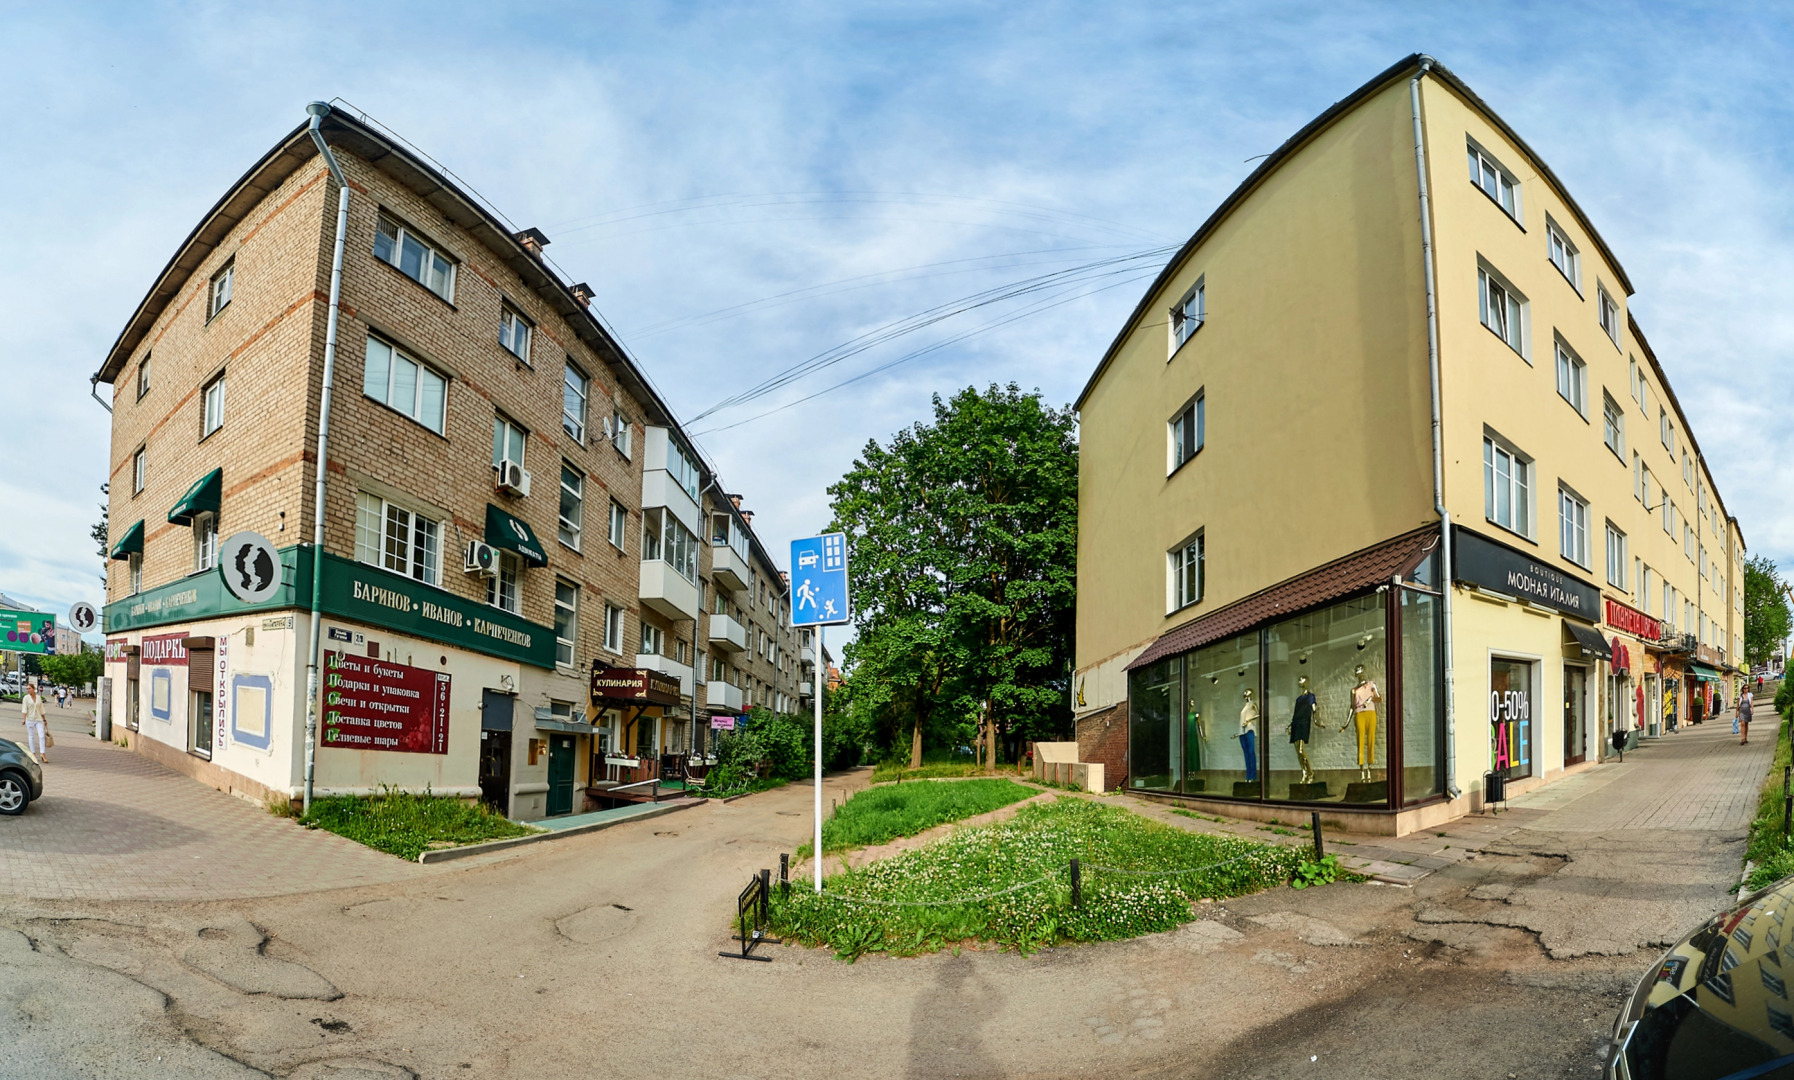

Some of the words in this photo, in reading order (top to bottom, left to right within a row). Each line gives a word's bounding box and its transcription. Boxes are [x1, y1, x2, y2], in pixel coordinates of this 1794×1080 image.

[1530, 564, 1563, 585] BOUTIQUE
[353, 580, 411, 612] БАРИНОВ
[422, 601, 463, 627] ИВАНОВ
[474, 617, 532, 648] КАРПЕЧЕНКОВ
[1606, 600, 1641, 634] ПЛАНЕТА
[143, 638, 186, 661] ПОДАРКИ
[219, 637, 227, 656] МЫ
[329, 656, 361, 672] Цветы
[364, 665, 370, 673] и
[373, 664, 404, 679] букеты
[329, 674, 370, 692] Подарки
[373, 684, 379, 693] и
[382, 685, 420, 699] упаковка
[596, 679, 643, 688] КУЛИНАРИЯ
[218, 660, 227, 747] ОТКРЫЛИСЬ
[328, 692, 357, 708] Свечи
[360, 699, 366, 708] и
[369, 700, 410, 714] открытки
[327, 711, 371, 727] Доставка
[374, 719, 403, 730] цветов
[327, 730, 372, 744] Гелиевые
[374, 735, 399, 748] шары
